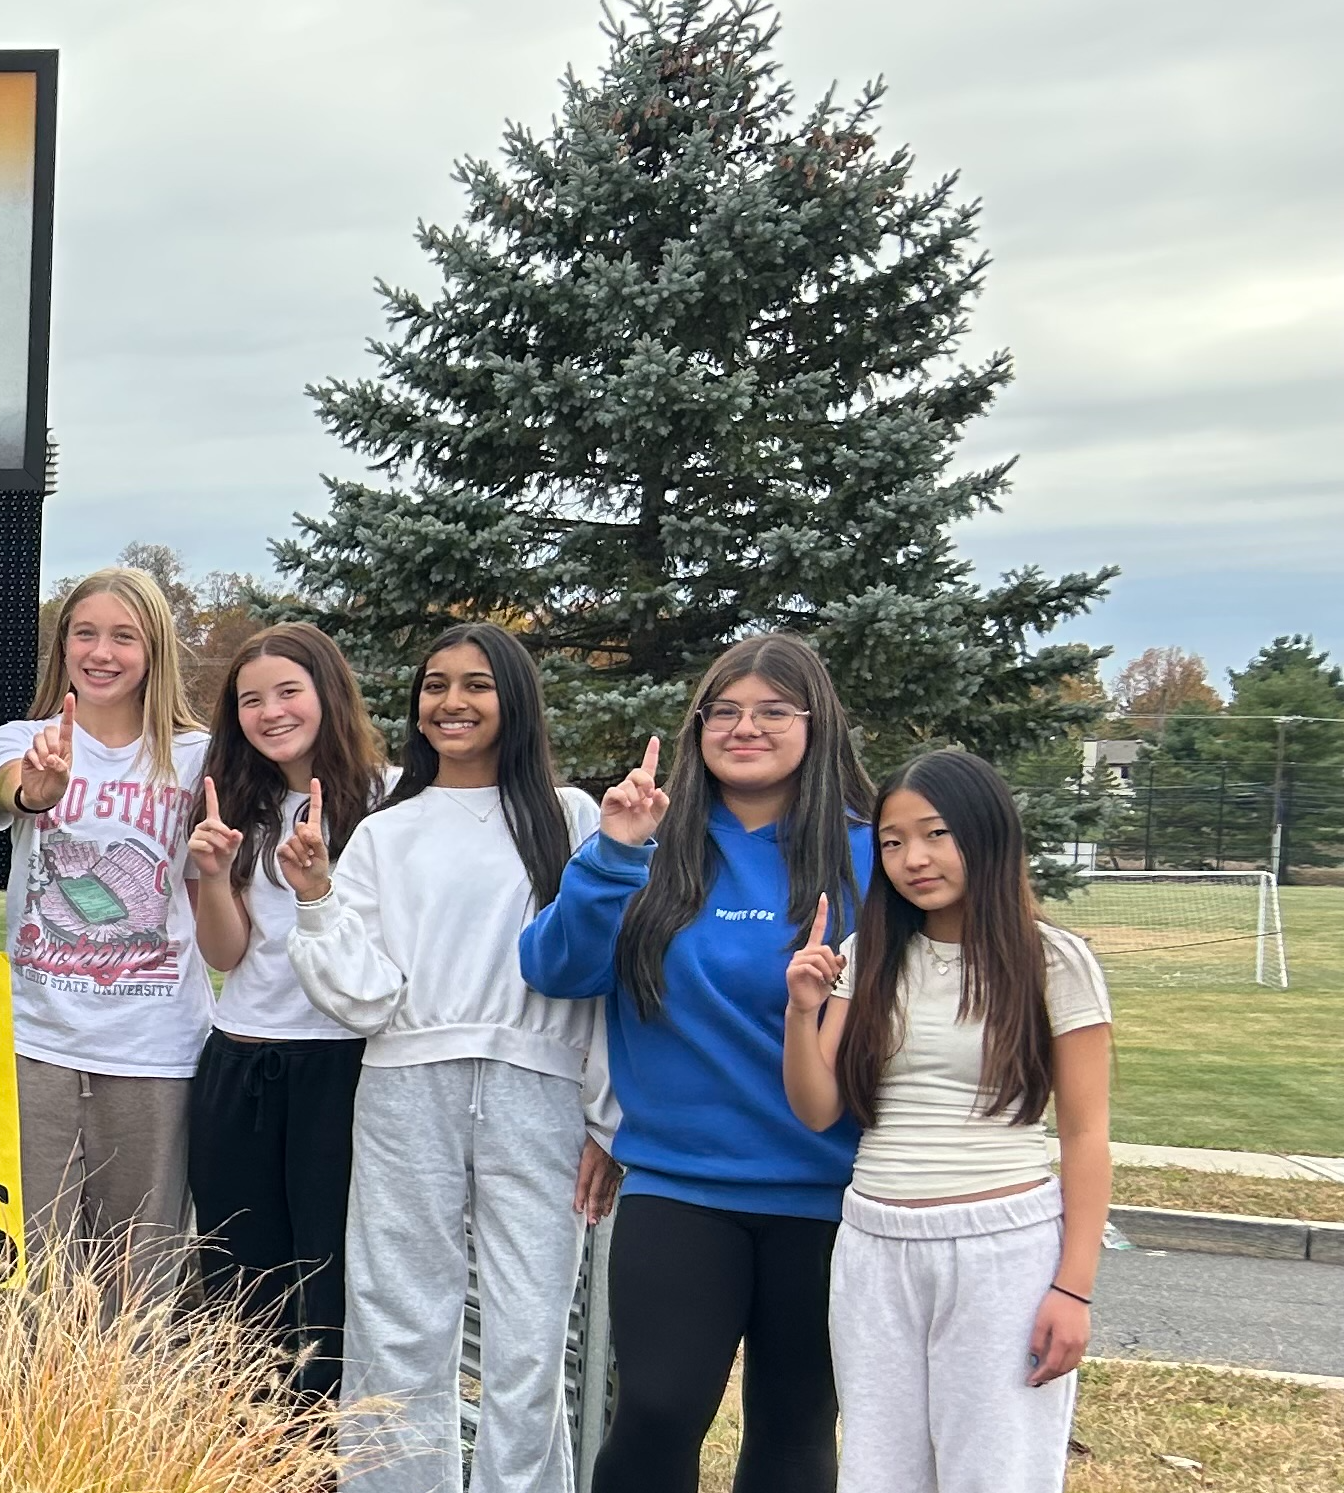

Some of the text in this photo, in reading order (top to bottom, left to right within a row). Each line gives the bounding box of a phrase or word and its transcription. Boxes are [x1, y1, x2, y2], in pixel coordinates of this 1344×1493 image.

[715, 908, 775, 921] WHITE FOX
[50, 977, 89, 994] STATE
[92, 983, 174, 997] UNIVERSITY
